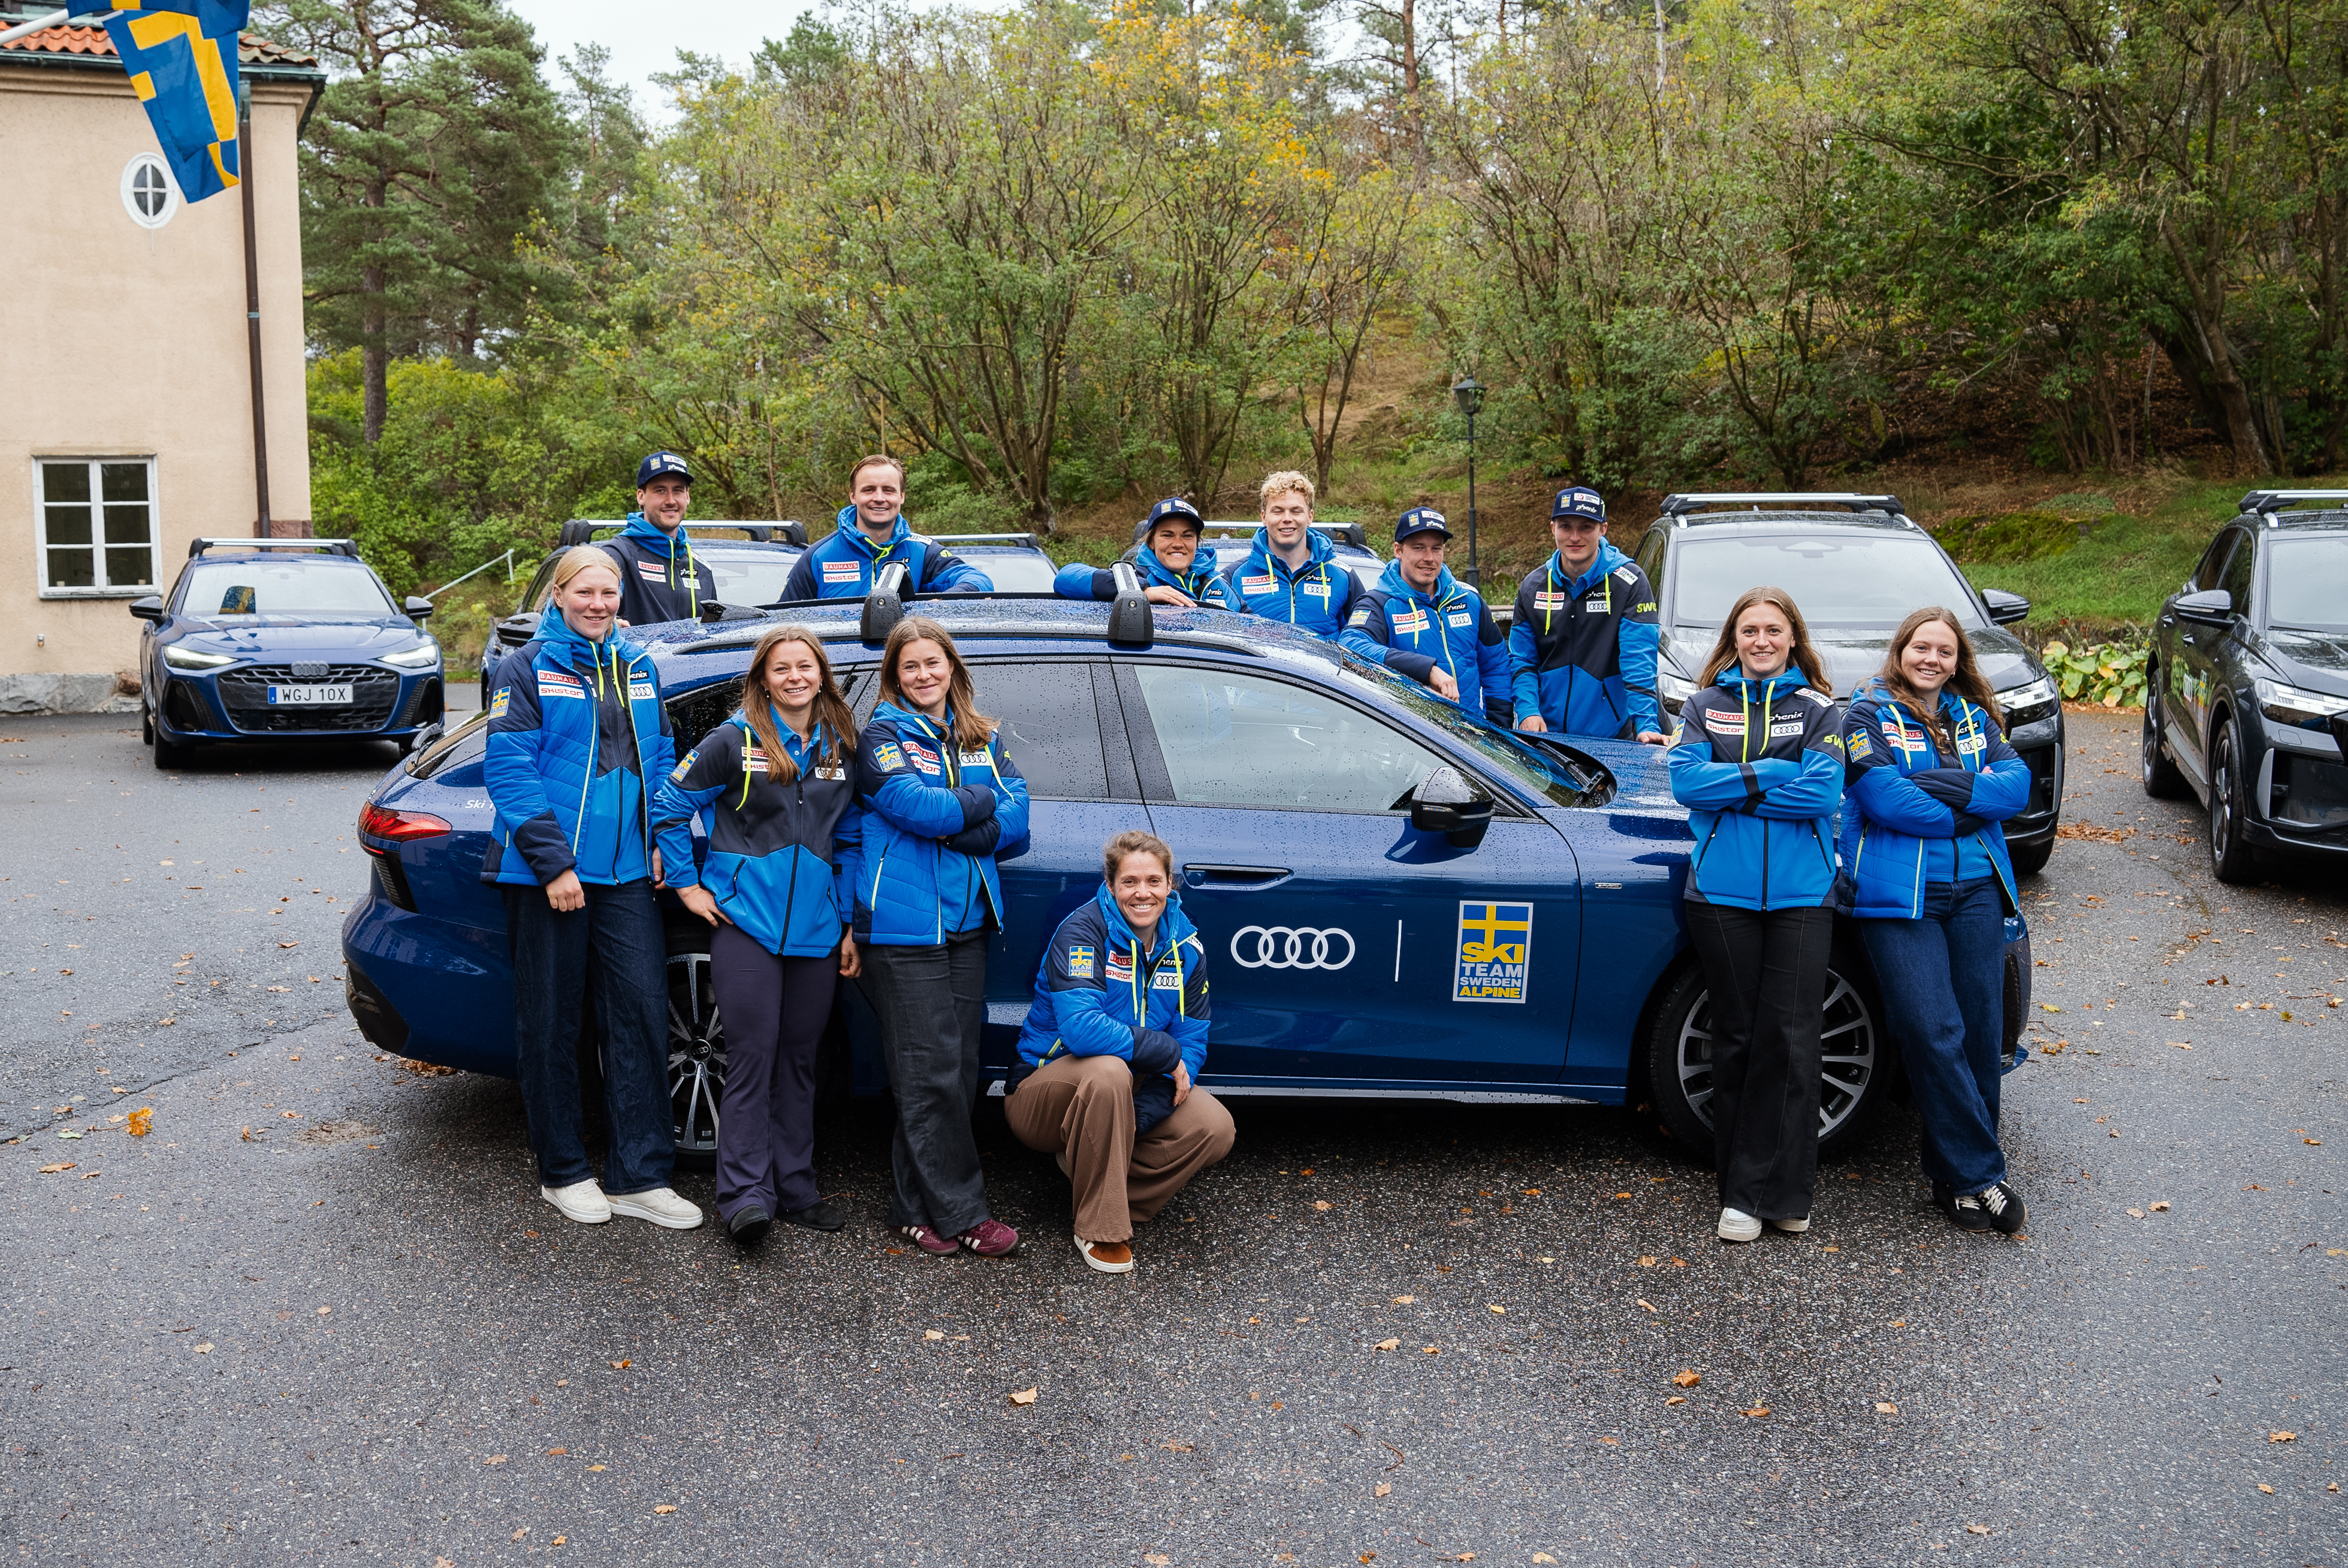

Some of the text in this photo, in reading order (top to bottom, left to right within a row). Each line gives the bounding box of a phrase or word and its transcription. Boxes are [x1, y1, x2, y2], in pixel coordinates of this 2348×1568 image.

[1446, 603, 1466, 612] phenix
[540, 672, 581, 684] BAUHAUS
[282, 688, 346, 701] WGJ 10X
[1708, 711, 1744, 721] BAUHAUS
[464, 799, 486, 809] Ski
[1462, 941, 1525, 963] SKI
[1462, 963, 1523, 978] TEAM
[1459, 977, 1522, 987] SWEDEN
[1459, 986, 1520, 998] ALPINE
